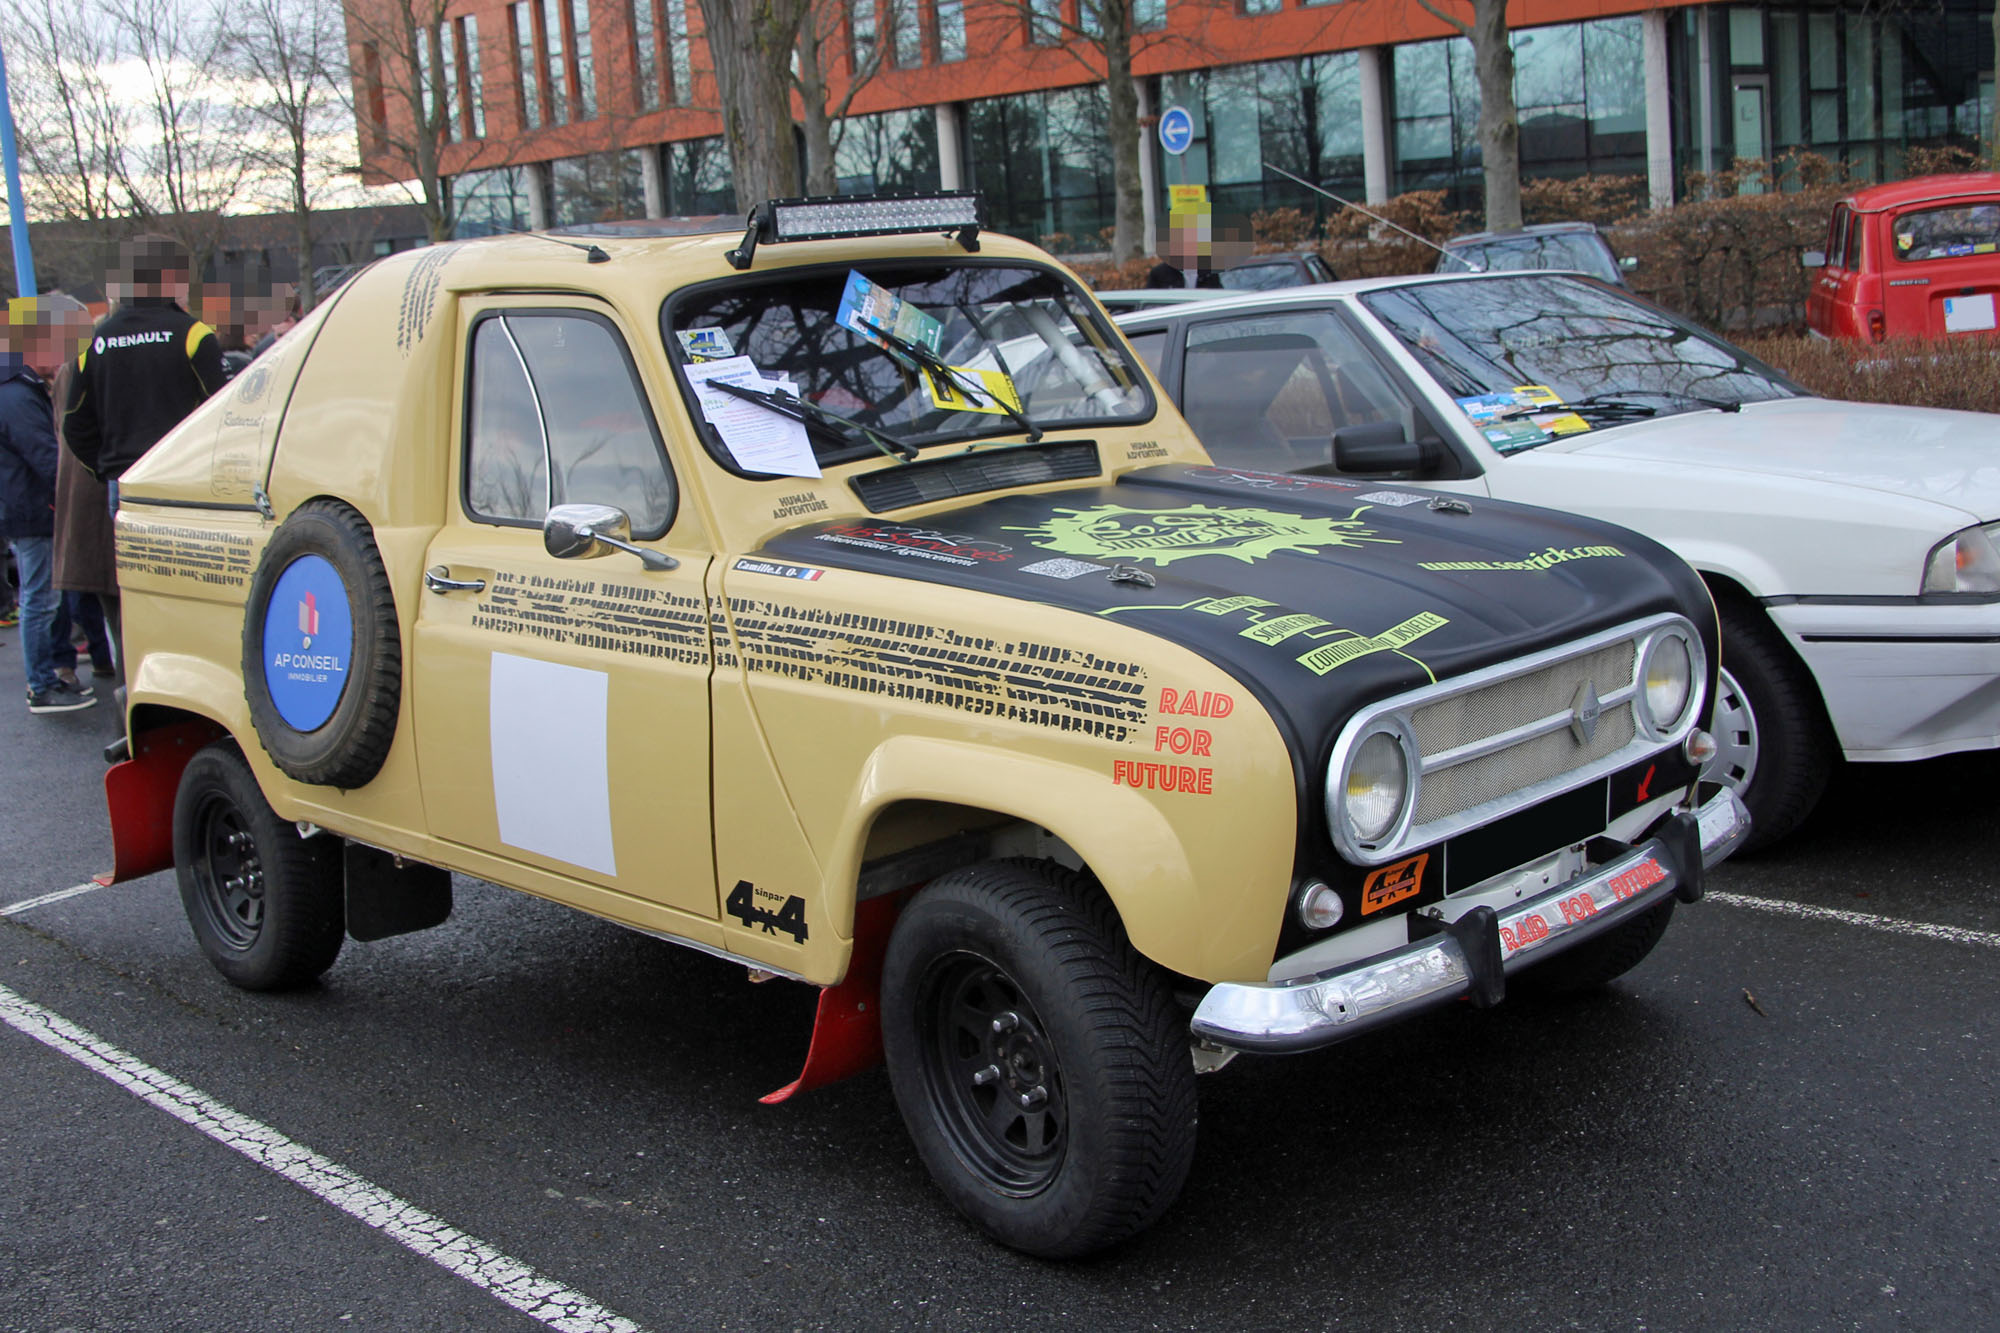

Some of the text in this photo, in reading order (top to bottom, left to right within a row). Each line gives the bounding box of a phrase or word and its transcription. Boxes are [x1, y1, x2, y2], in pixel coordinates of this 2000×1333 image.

[107, 331, 173, 348] RENAULT
[1127, 448, 1169, 459] ADVENTURE
[1130, 441, 1159, 450] HUMAN
[778, 491, 817, 507] HUMAN
[772, 500, 829, 519] ADVENTURE
[1391, 612, 1442, 643] VISUELLE
[274, 653, 344, 671] AP CONSEIL
[288, 672, 328, 683] IMMOBILIER
[1158, 687, 1234, 718] RAID
[1154, 726, 1212, 757] FOR
[1112, 760, 1213, 795] FUTURE
[755, 888, 785, 902] sinpar
[1499, 858, 1666, 951] RAID FOR FUTURE
